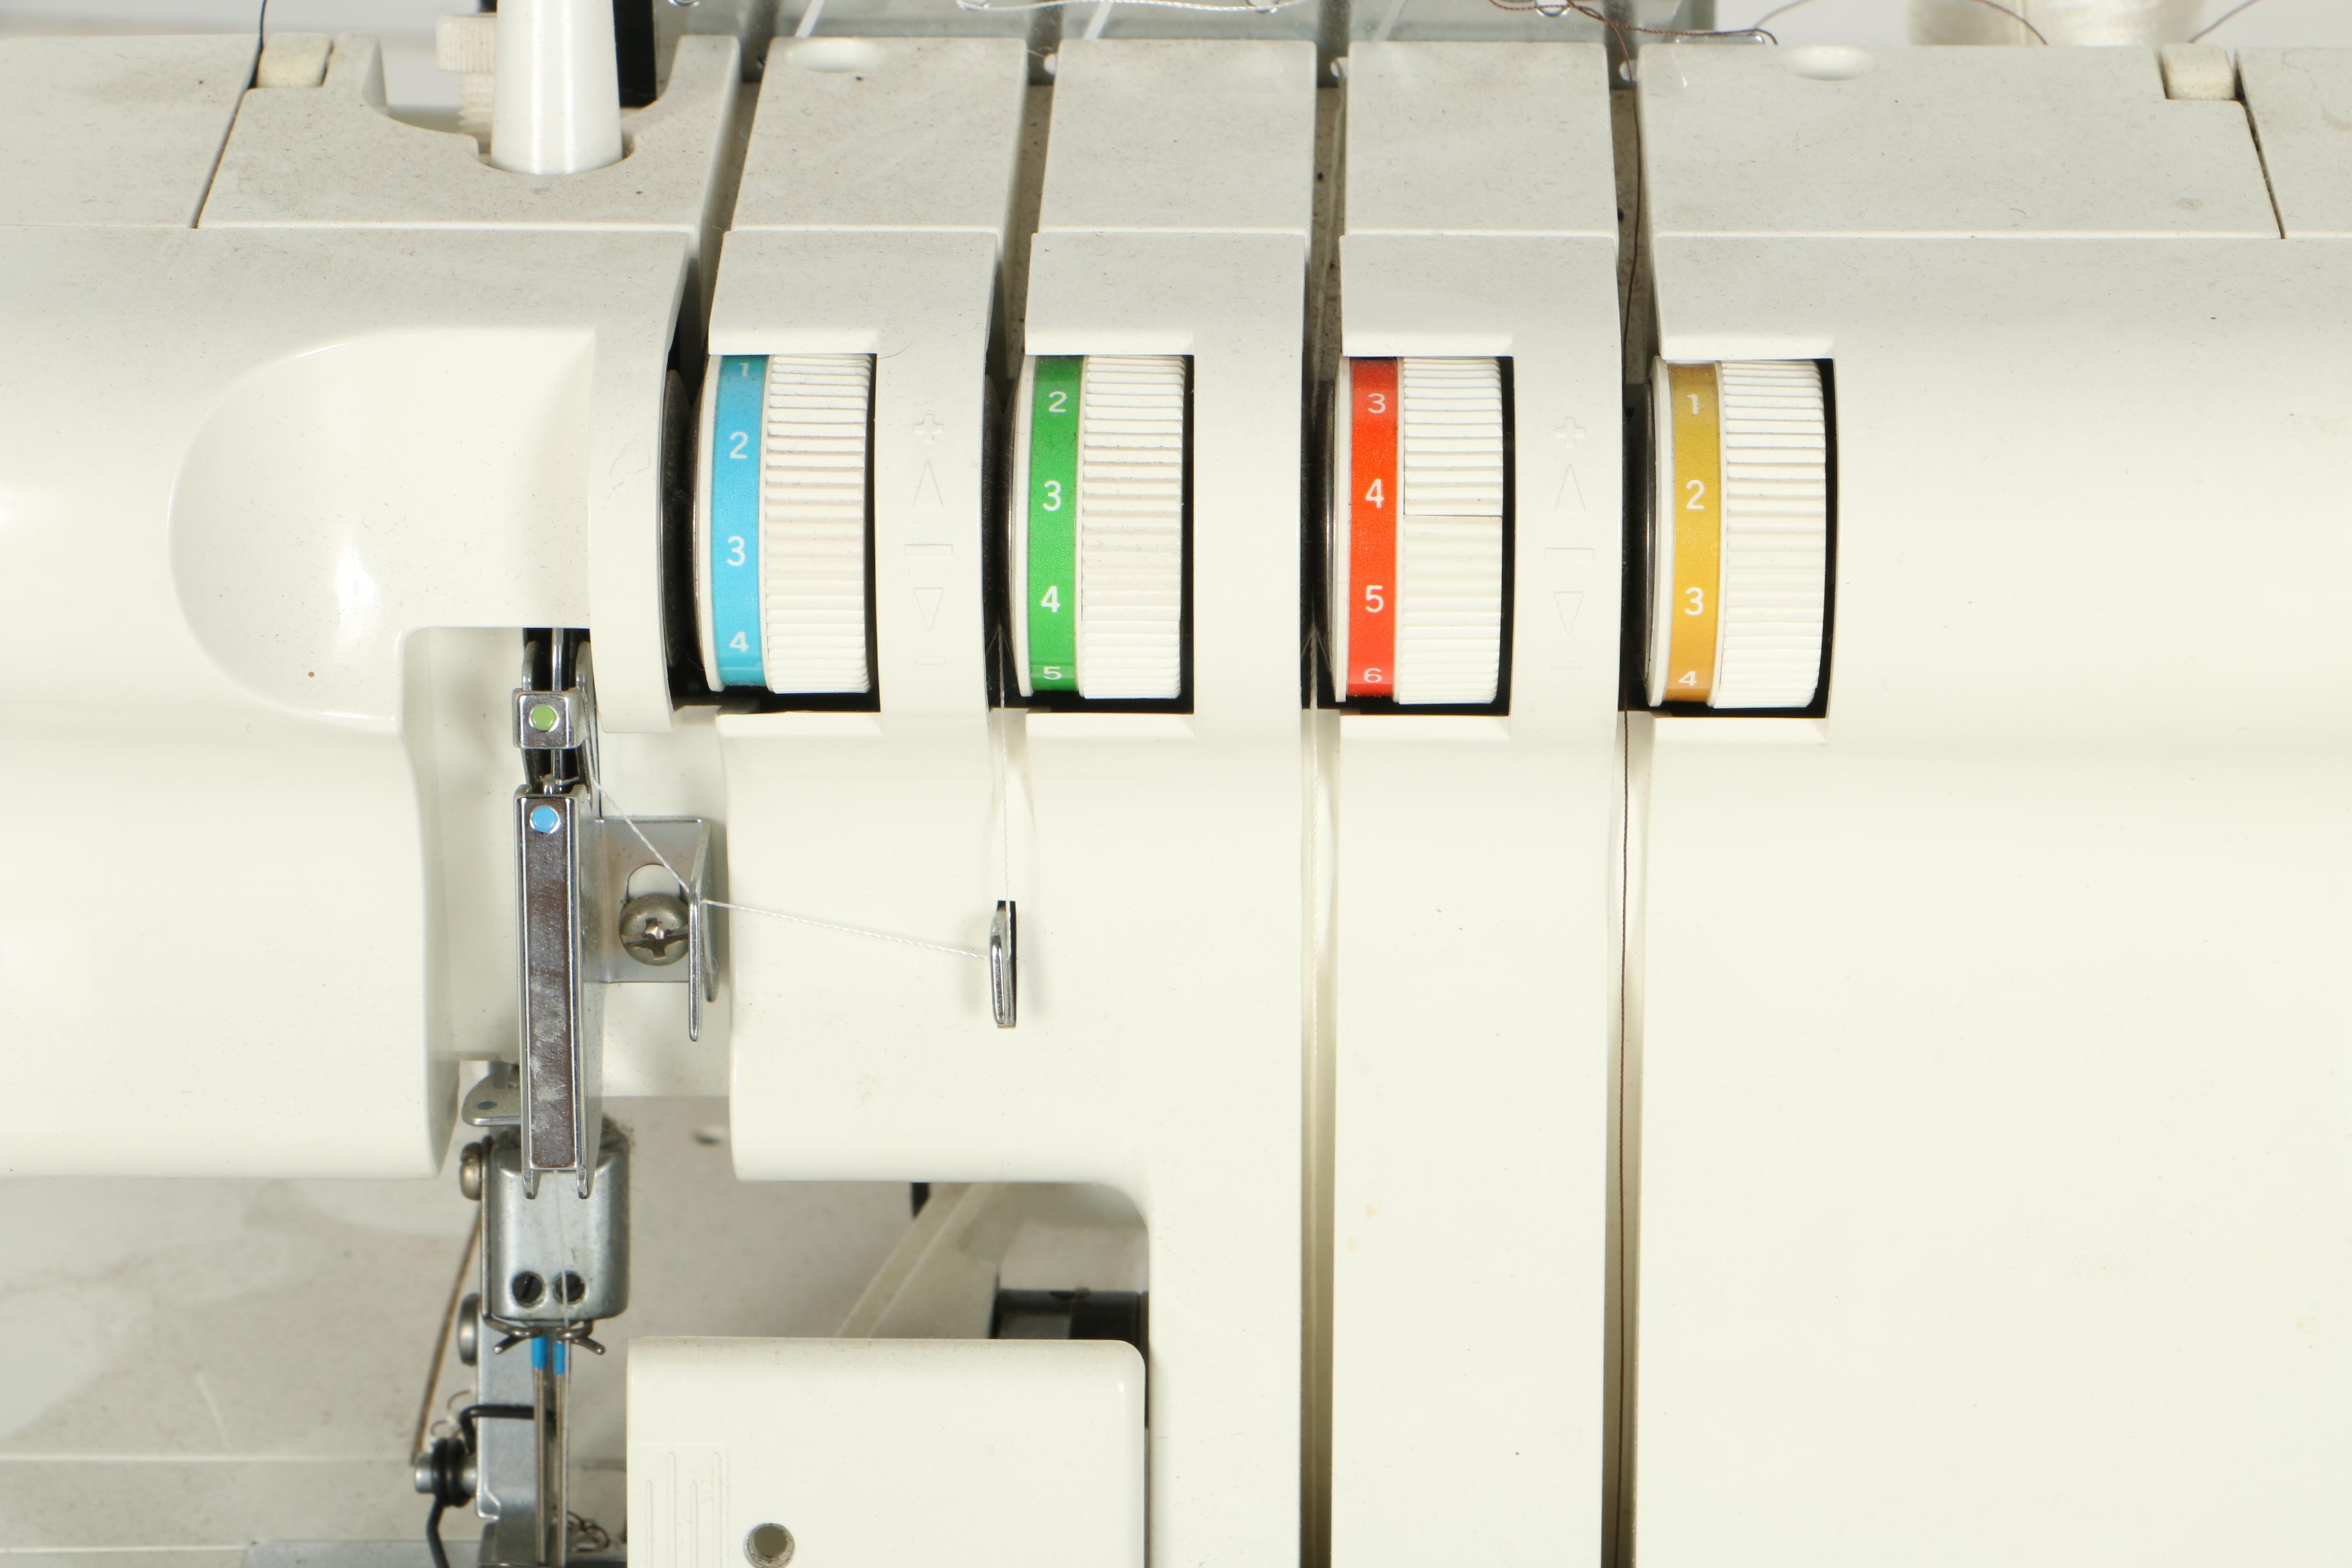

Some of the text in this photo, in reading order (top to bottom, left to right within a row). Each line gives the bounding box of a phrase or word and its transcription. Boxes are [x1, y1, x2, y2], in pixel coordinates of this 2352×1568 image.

[738, 362, 749, 378] 1
[1048, 391, 1067, 413] 2
[1367, 393, 1386, 415] 3
[1687, 394, 1700, 415] 1
[729, 431, 749, 459] 2
[1042, 479, 1062, 511] 3
[1365, 478, 1385, 509] 4
[1686, 479, 1705, 511] 2
[727, 535, 746, 567] 3
[1040, 585, 1061, 613] 4
[1366, 585, 1384, 613] 5
[1684, 587, 1704, 616] 3
[729, 631, 749, 652] 4
[1043, 665, 1063, 680] 5
[1363, 667, 1383, 683] 6
[1678, 671, 1698, 687] 4
